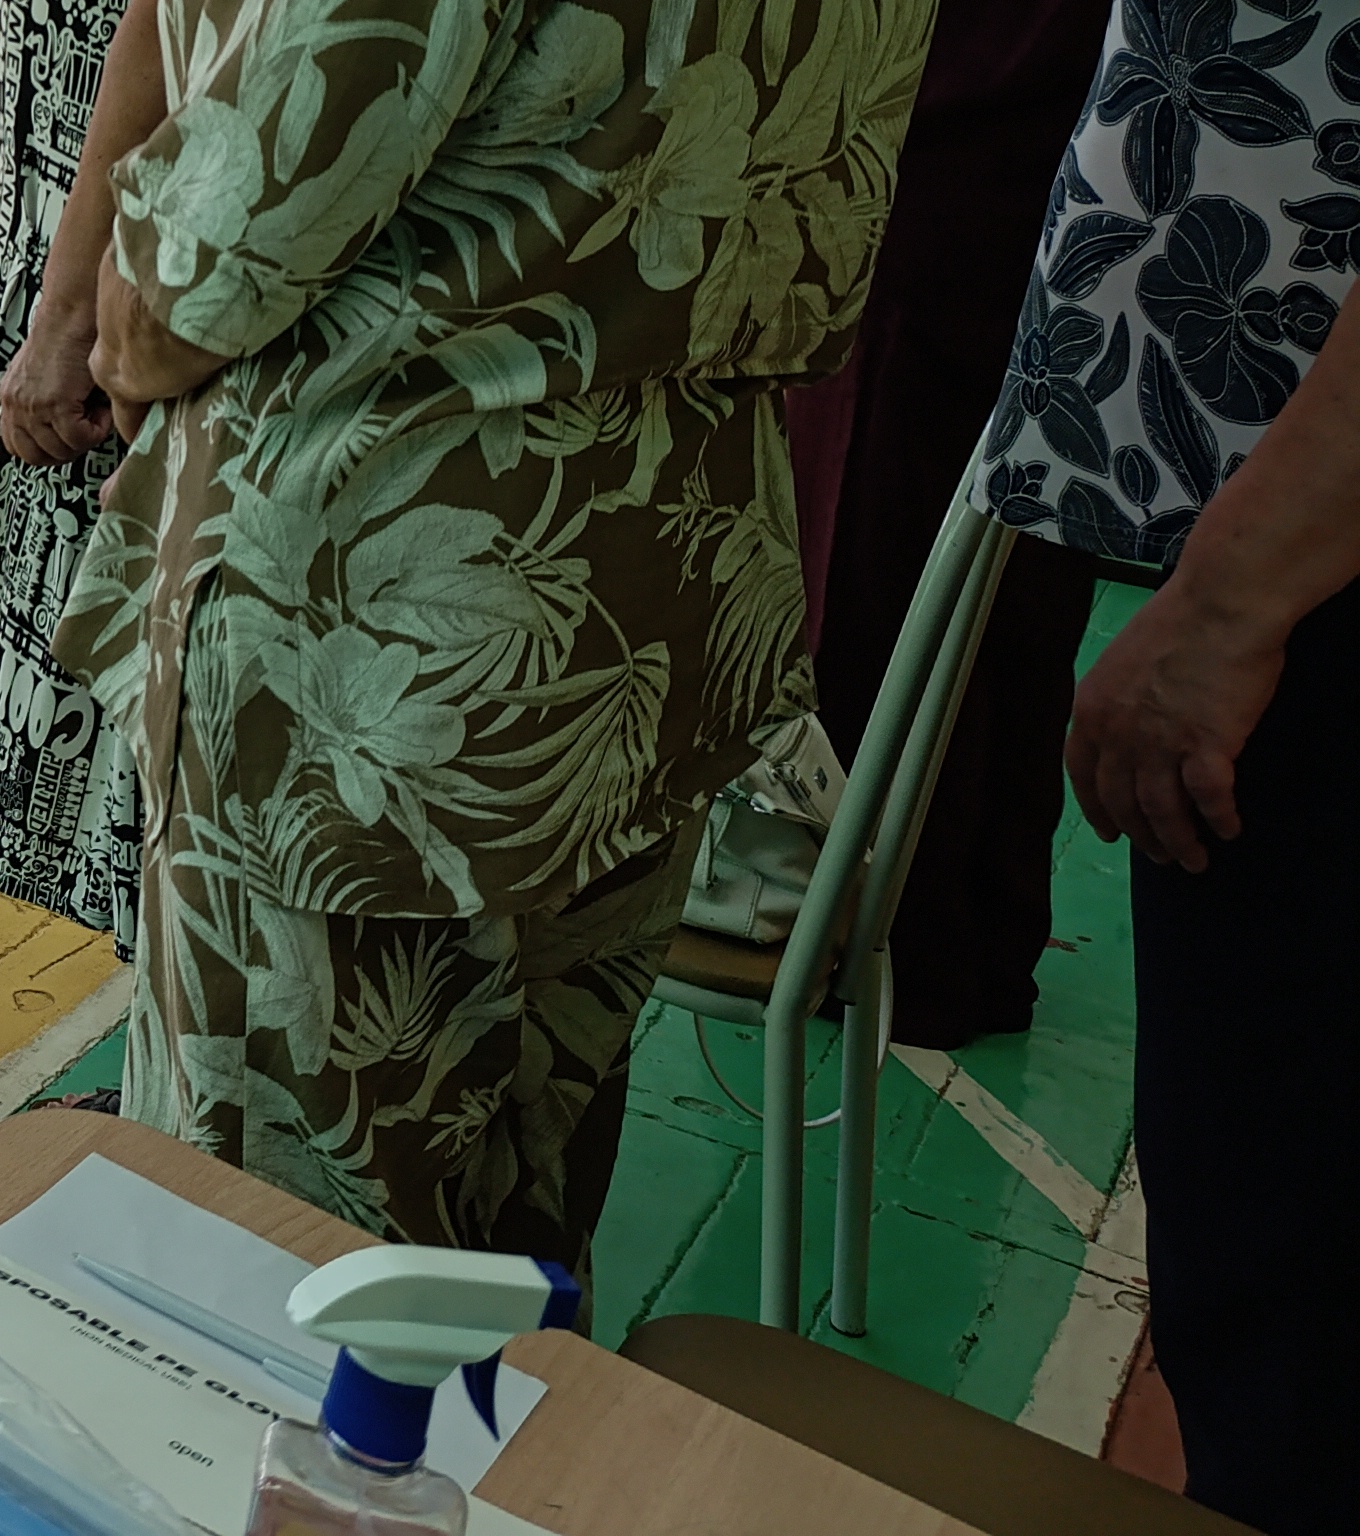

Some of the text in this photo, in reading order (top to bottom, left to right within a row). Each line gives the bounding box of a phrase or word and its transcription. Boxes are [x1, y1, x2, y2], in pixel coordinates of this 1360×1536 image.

[69, 1325, 194, 1391] (NON MEDICAL USE)
[153, 1353, 200, 1379] PE
[168, 1439, 215, 1467] open
